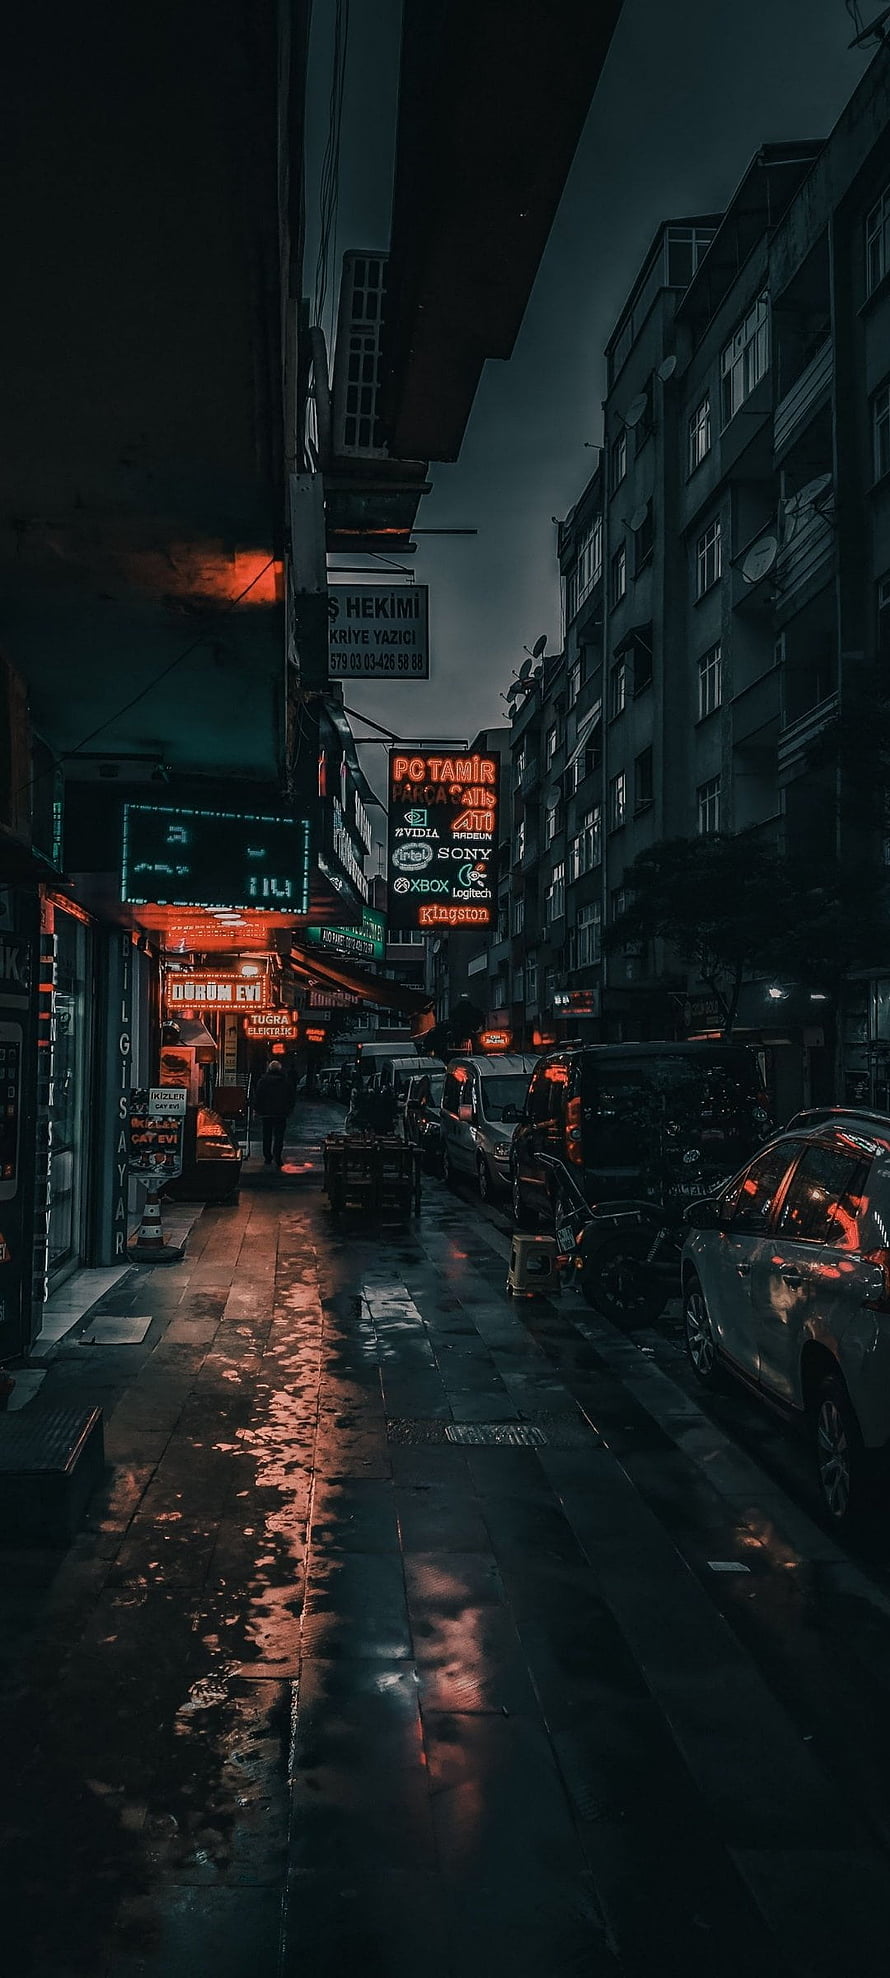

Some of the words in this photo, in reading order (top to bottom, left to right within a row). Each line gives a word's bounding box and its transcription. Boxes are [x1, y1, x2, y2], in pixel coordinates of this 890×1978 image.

[346, 593, 419, 619] HEKİMİ
[330, 626, 369, 644] KRİYE
[373, 630, 416, 645] YAZICI
[331, 654, 347, 670] 579
[350, 653, 361, 670] 03
[398, 654, 409, 670] 58
[411, 654, 423, 670] 88
[392, 757, 426, 782] PC
[427, 754, 496, 784] TAMİR
[392, 783, 447, 806] PARÇA
[437, 847, 492, 861] SONY
[410, 879, 449, 893] XBOX
[452, 887, 492, 900] Logitech
[418, 904, 492, 926] Kingston
[171, 981, 232, 1001] DÜRÜM
[236, 982, 261, 1002] EVİ
[251, 1013, 289, 1025] TUĞRA
[247, 1026, 293, 1036] ELEKTRİK
[115, 934, 130, 1255] BİLGİSAYAR
